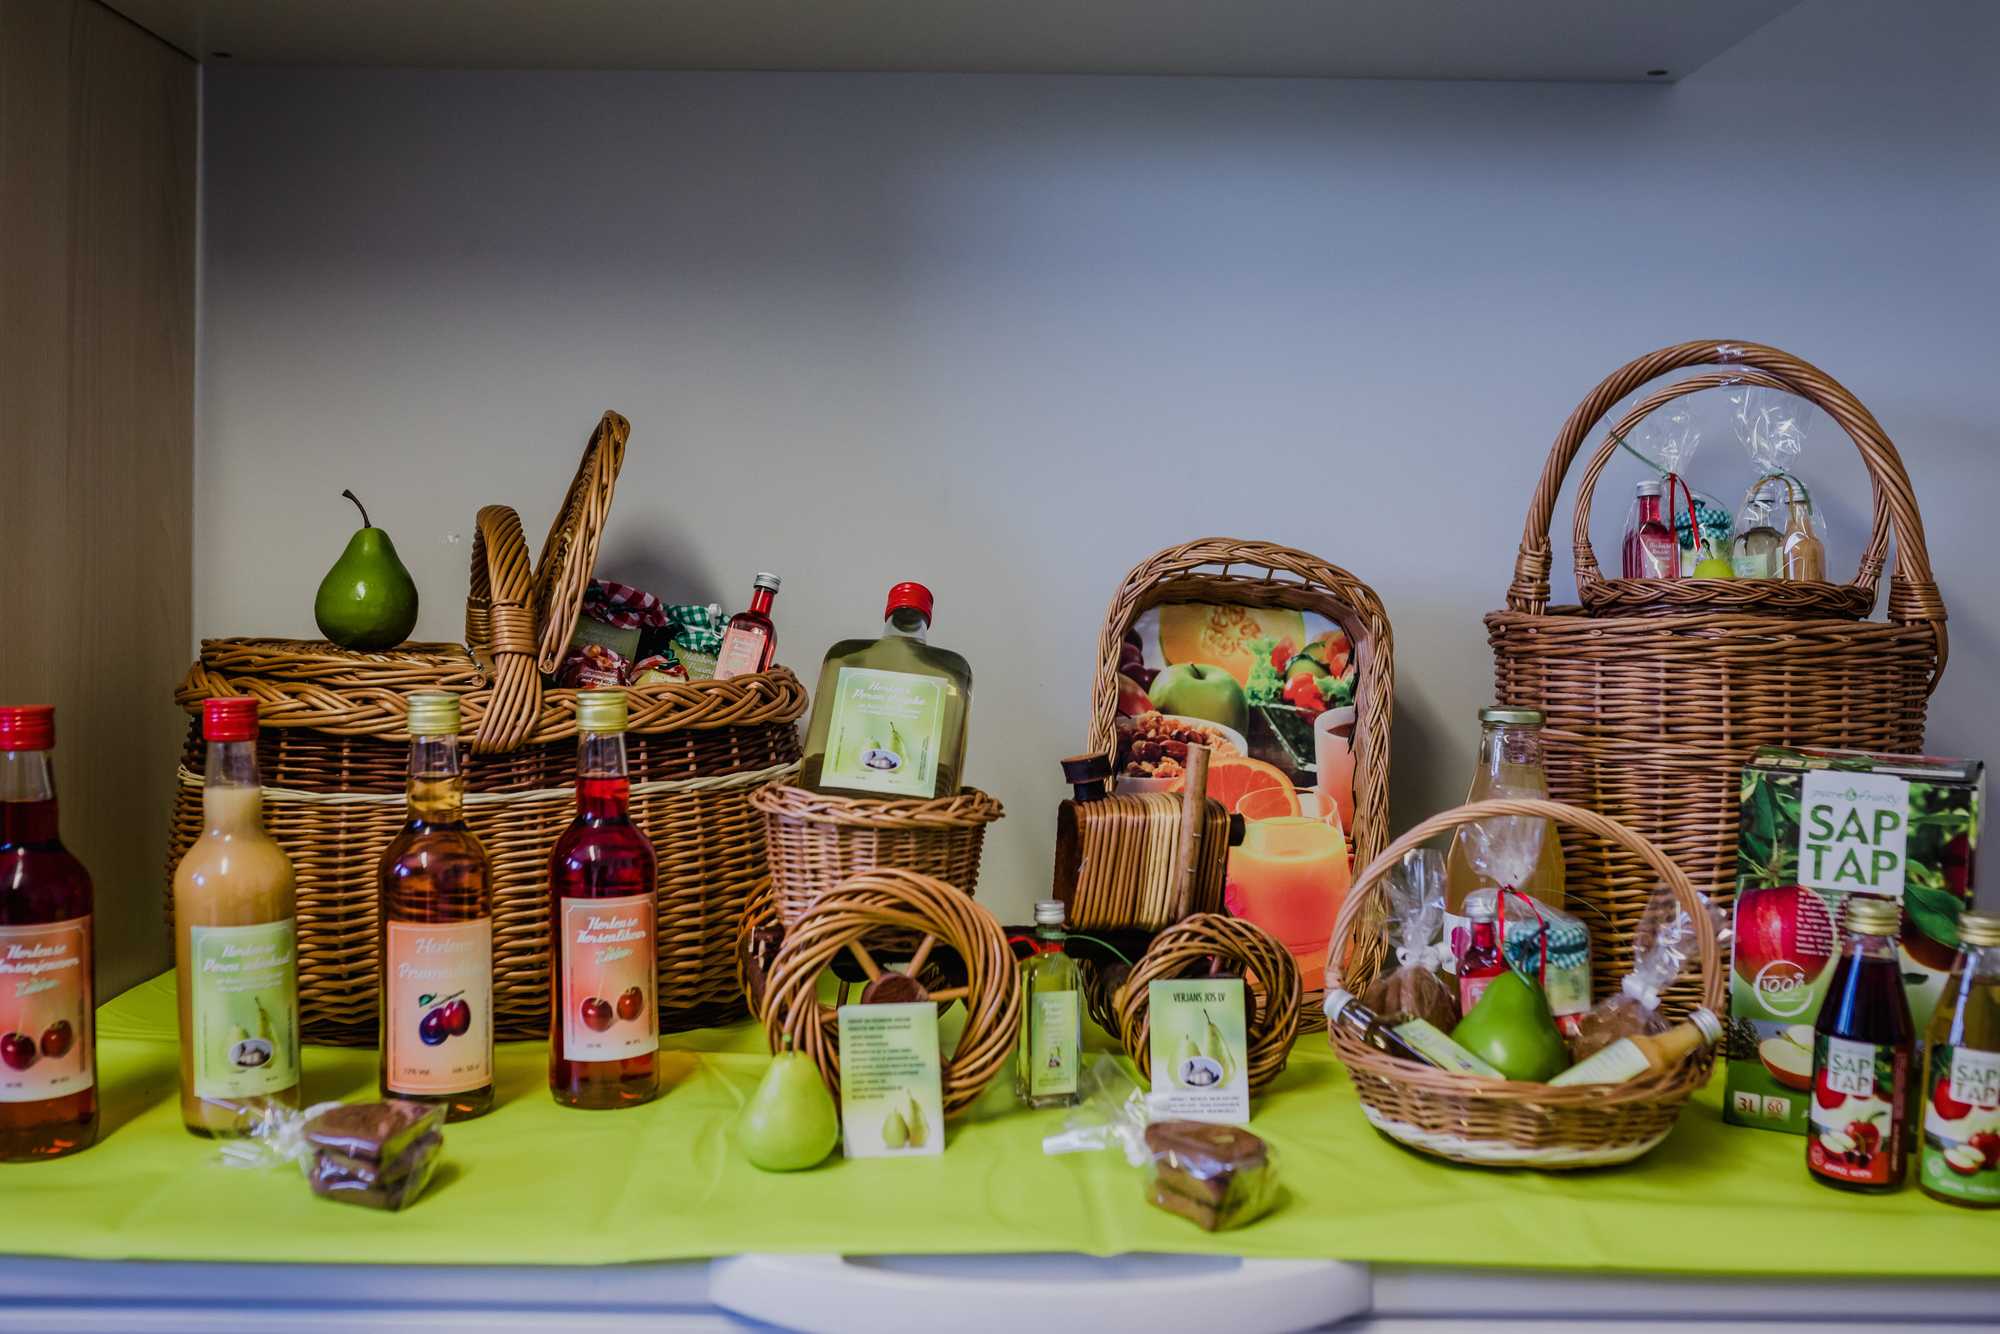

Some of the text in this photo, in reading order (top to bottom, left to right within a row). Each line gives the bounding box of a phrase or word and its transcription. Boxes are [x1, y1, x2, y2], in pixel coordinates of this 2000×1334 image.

[1808, 804, 1901, 845] SAP
[1806, 844, 1899, 886] TAP
[1172, 992, 1203, 1002] VERJANS
[1833, 1054, 1871, 1075] SAP
[1831, 1071, 1870, 1093] TAP
